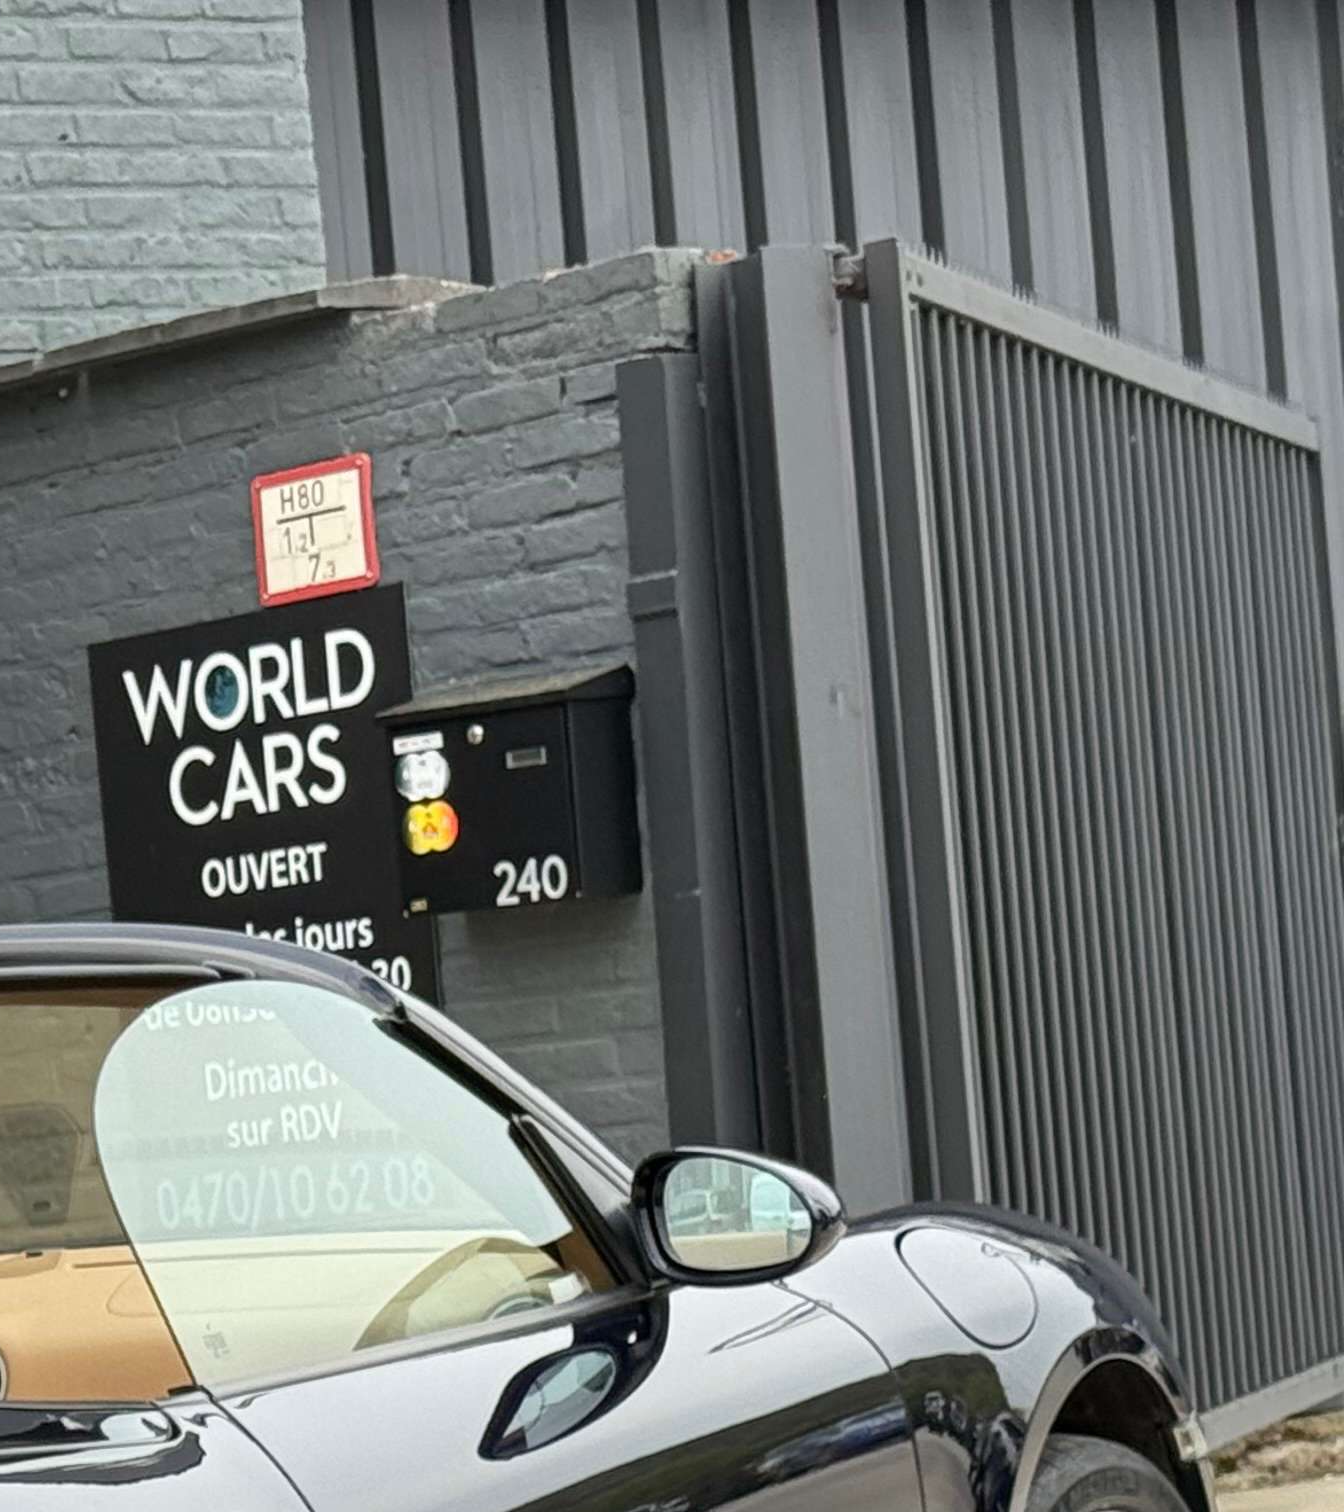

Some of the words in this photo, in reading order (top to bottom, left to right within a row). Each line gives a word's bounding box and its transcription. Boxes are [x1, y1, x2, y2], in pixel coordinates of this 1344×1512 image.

[280, 480, 324, 514] H80
[122, 628, 375, 746] WORLD
[169, 723, 347, 826] CARS
[201, 842, 327, 898] OUVERT
[493, 855, 568, 907] 240
[294, 916, 374, 952] jours
[227, 1117, 274, 1149] sur
[280, 1100, 344, 1143] RDV
[327, 1159, 373, 1215] 62
[382, 1152, 435, 1208] 08
